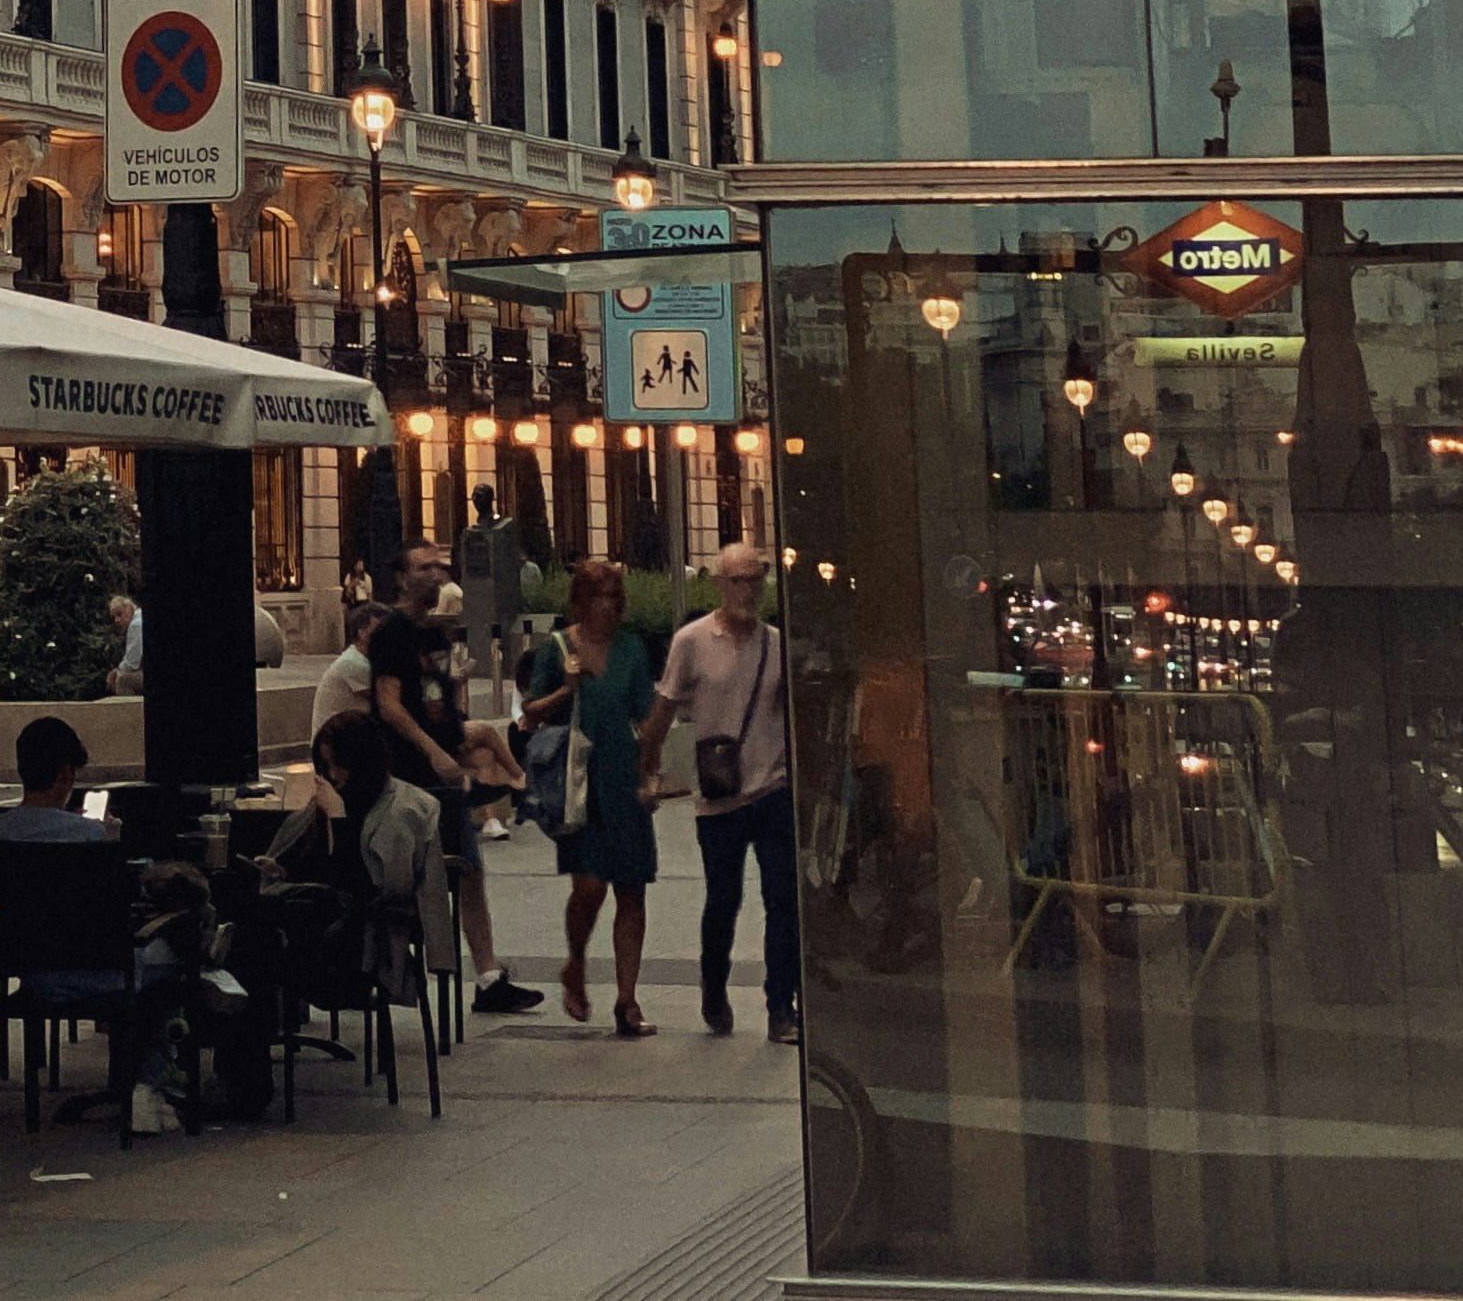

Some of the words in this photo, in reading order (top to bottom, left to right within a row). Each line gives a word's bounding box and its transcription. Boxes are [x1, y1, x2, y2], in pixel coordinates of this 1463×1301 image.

[123, 145, 220, 166] VEHÍCULOS
[128, 170, 150, 186] DE
[155, 168, 216, 185] MOTOR
[652, 224, 724, 239] ZONA
[29, 374, 148, 417] STARBUCKS
[151, 386, 226, 426] COFFEE
[315, 398, 377, 429] COFFEE
